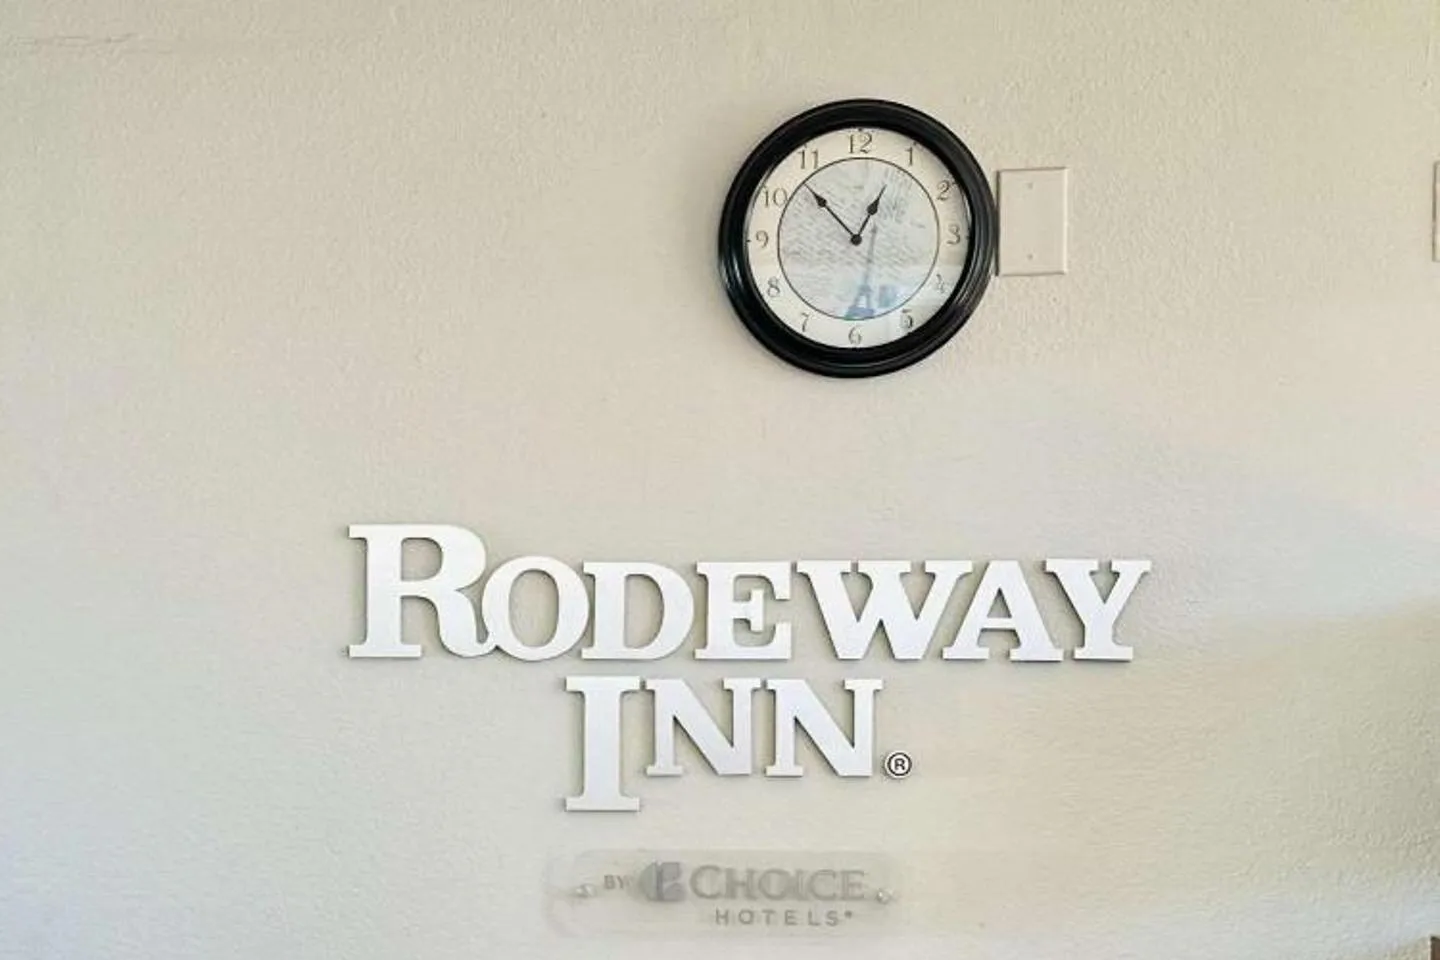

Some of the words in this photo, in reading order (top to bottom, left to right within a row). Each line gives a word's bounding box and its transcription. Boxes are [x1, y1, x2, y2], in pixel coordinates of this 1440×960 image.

[847, 134, 873, 155] 12
[798, 149, 820, 169] 11
[348, 524, 1152, 663] RODEWAY
[603, 874, 627, 890] BY
[689, 865, 866, 901] CHOICE
